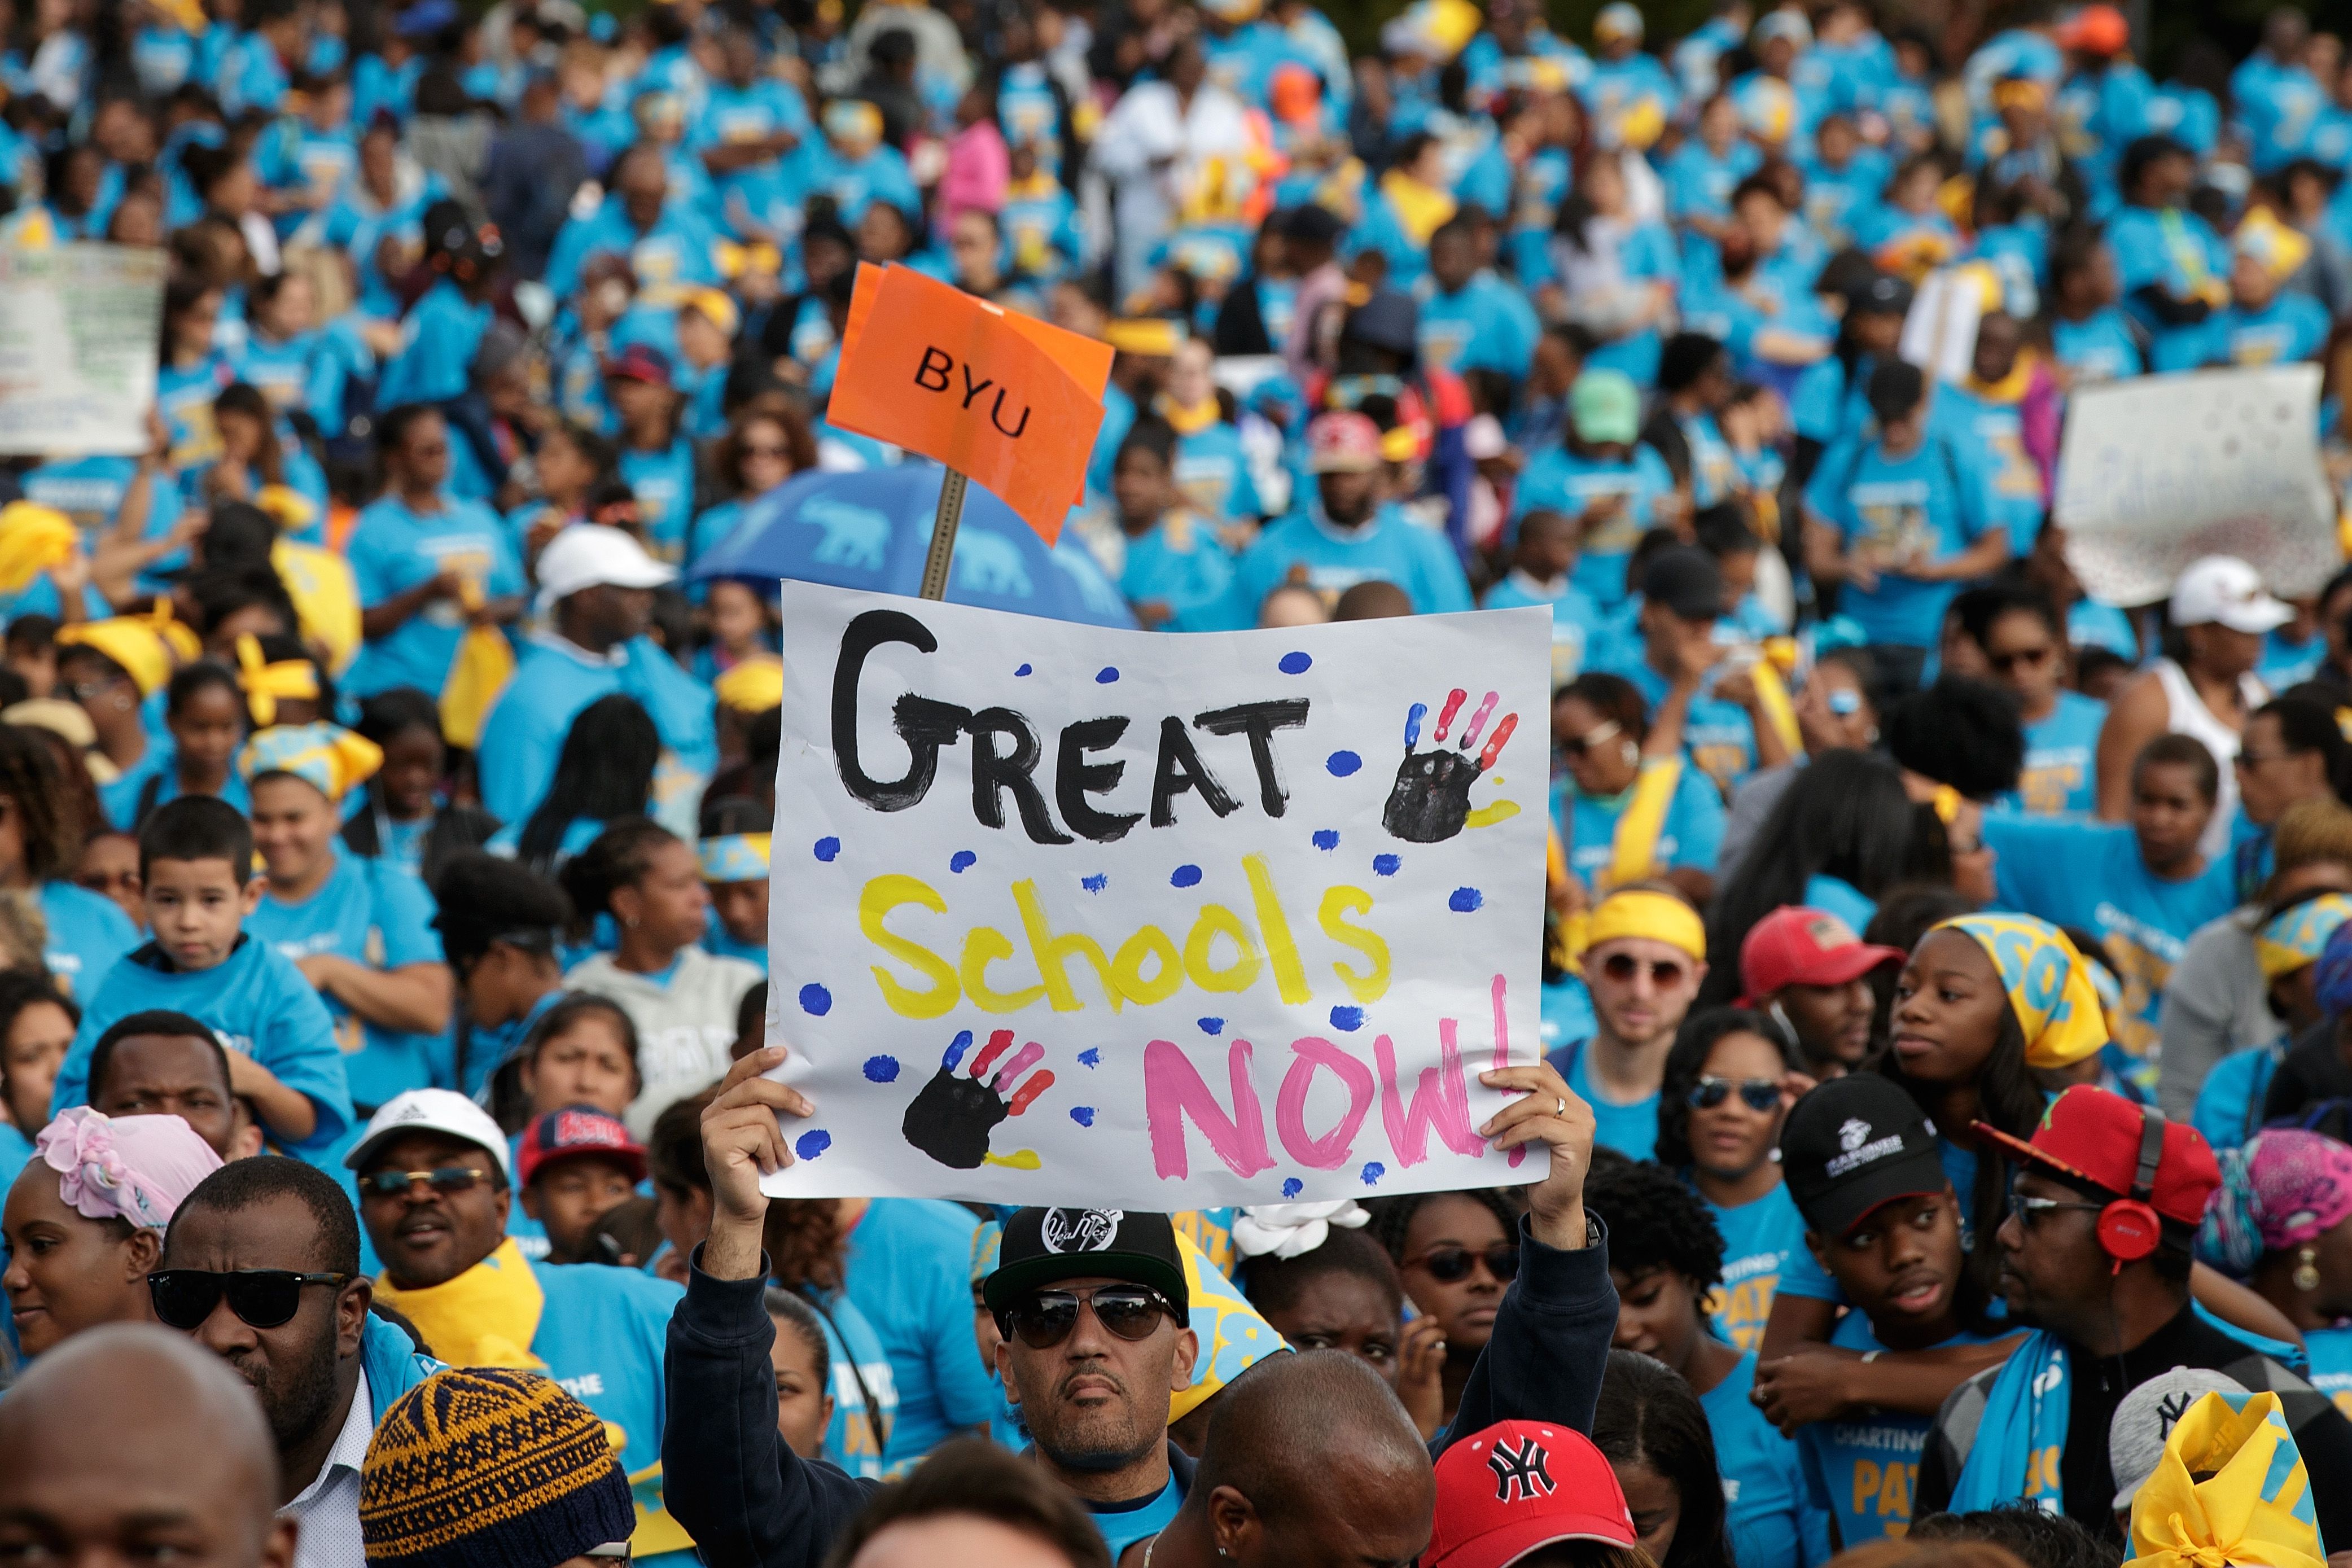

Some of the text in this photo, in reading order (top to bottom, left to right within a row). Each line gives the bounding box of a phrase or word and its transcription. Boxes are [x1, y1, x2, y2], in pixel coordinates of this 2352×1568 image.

[914, 345, 1031, 439] BYU
[859, 852, 1392, 1020] Schools
[1144, 973, 1527, 1182] NOW!
